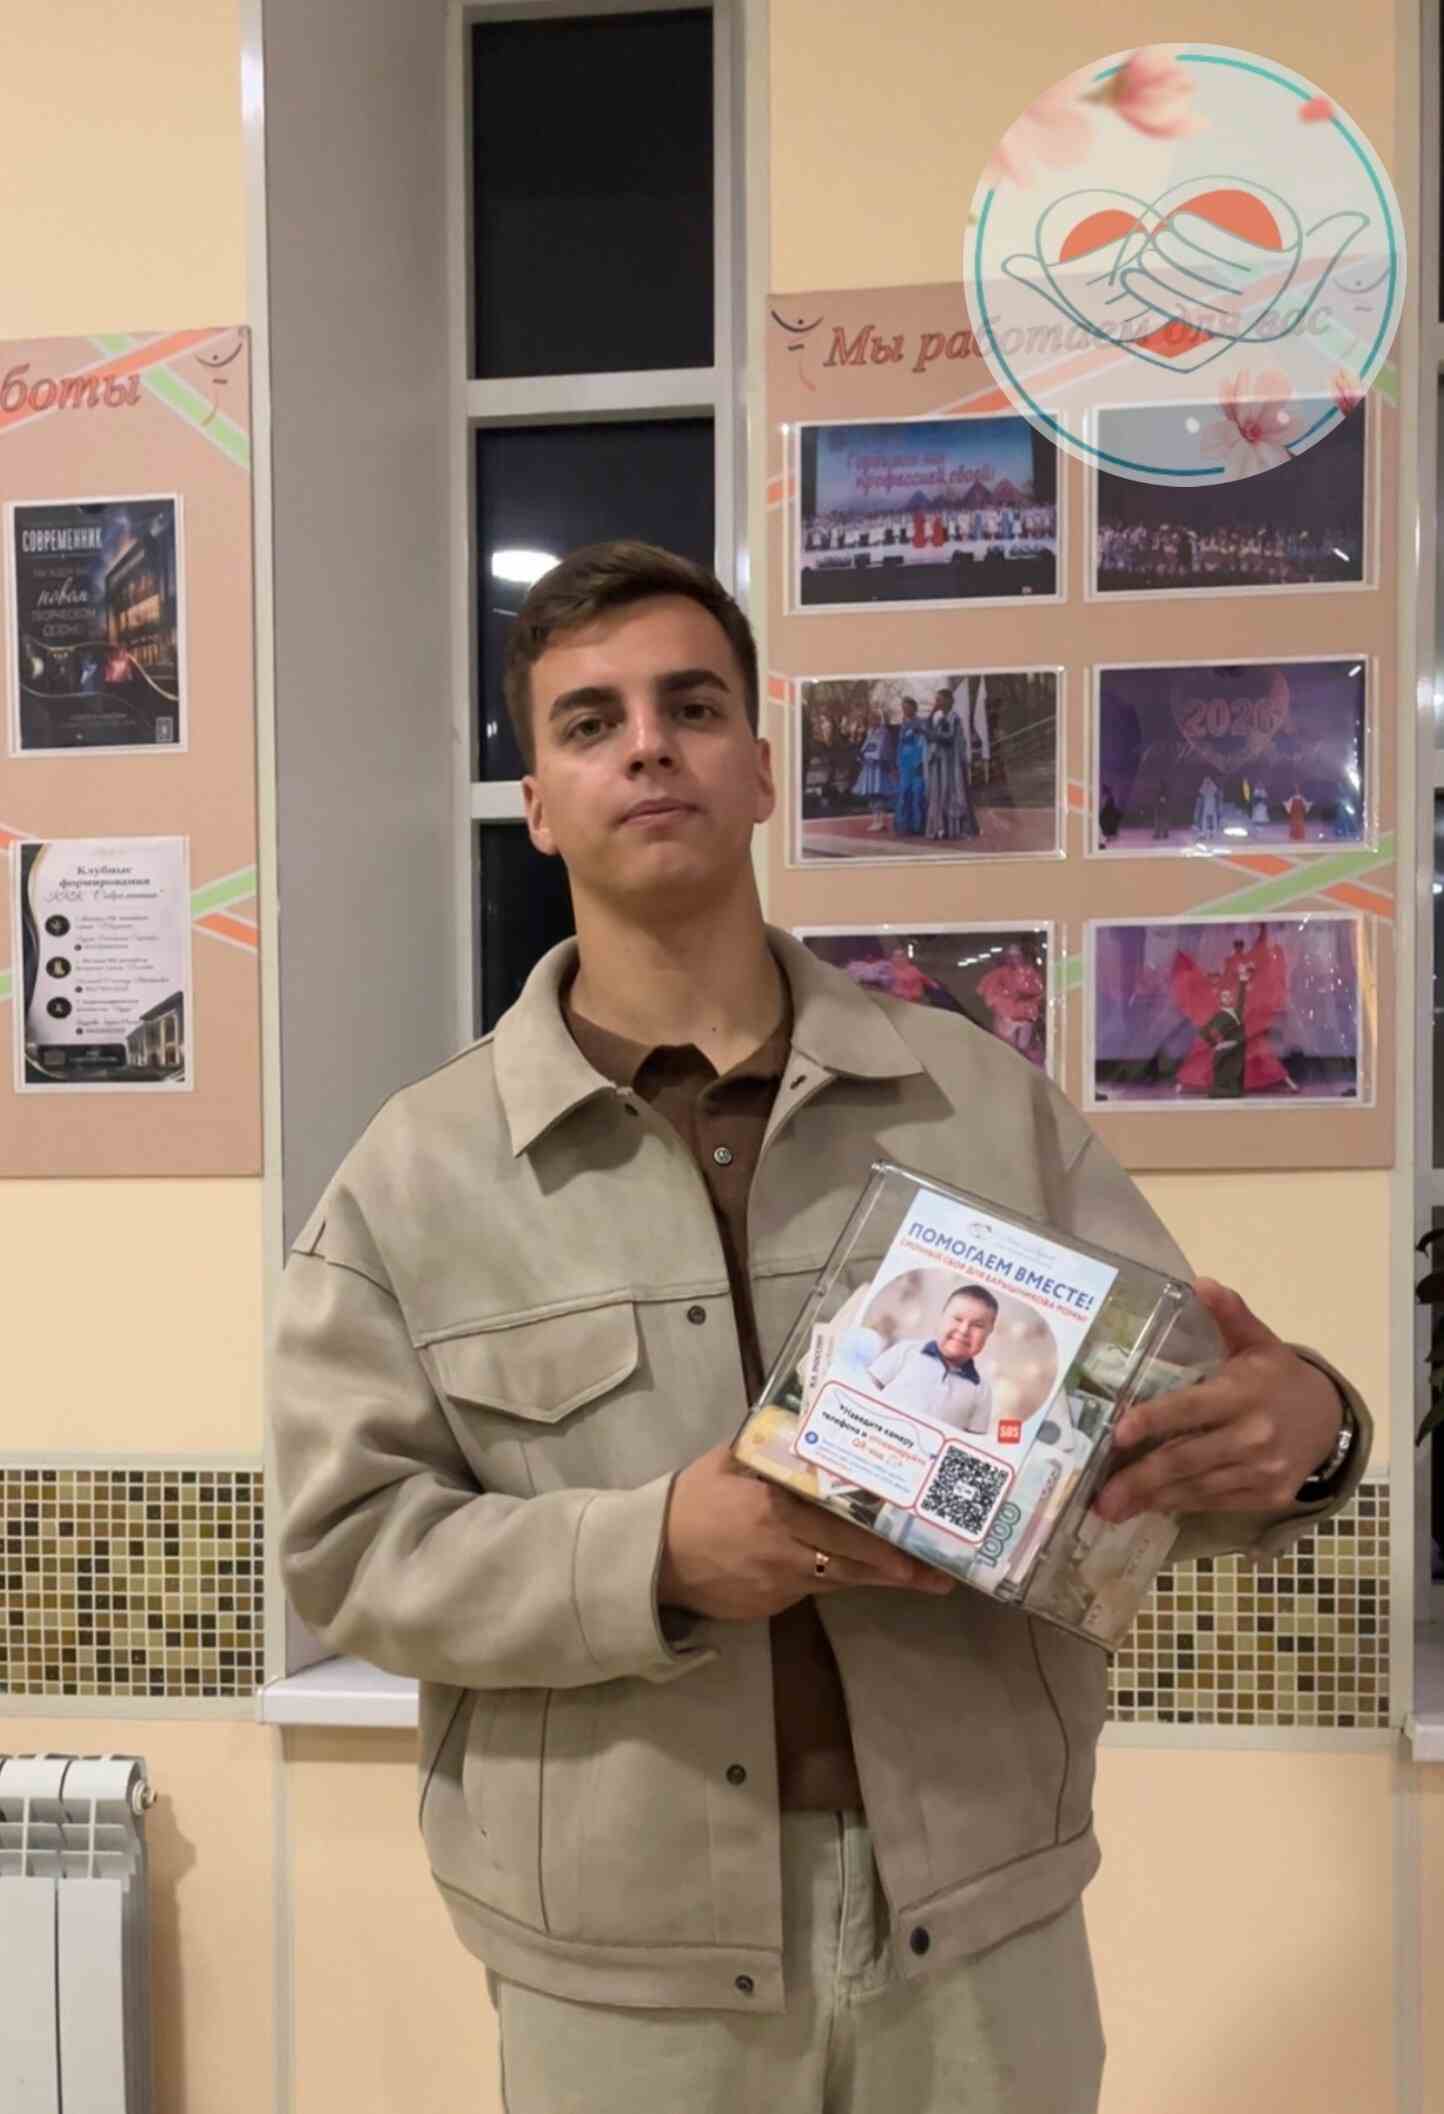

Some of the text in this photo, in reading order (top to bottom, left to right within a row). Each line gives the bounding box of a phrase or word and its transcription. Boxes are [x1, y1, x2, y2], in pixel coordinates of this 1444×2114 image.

[822, 324, 905, 367] Мы
[911, 314, 1151, 373] работаем
[1, 362, 141, 412] боты
[22, 528, 102, 552] СОВРЕМЕННИК
[908, 1222, 1013, 1277] ПОМОГАЕМ
[1014, 1266, 1095, 1311] ВМЕСТЕ!
[976, 1502, 1021, 1568] 1000
